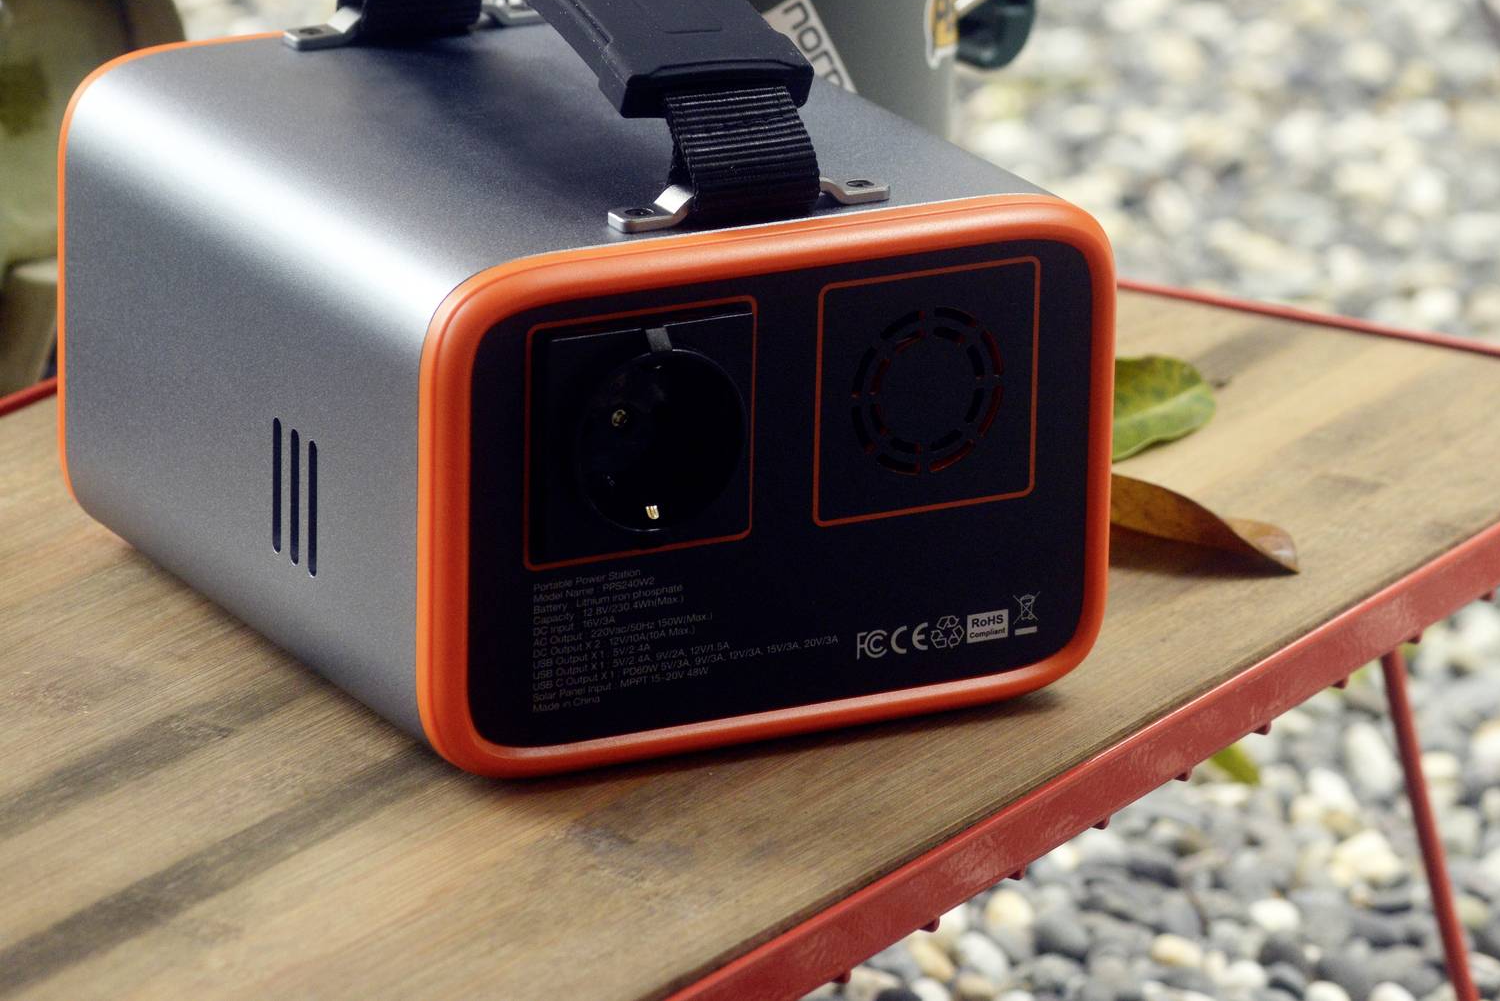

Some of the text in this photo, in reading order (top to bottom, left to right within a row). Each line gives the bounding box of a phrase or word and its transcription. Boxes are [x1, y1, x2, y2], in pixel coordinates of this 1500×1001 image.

[575, 574, 606, 585] Power
[971, 614, 1004, 629] RoHS
[890, 622, 929, 655] CE
[969, 627, 1006, 640] Compliant
[555, 653, 588, 665] Output
[555, 664, 588, 676] Output
[573, 696, 600, 706] China
